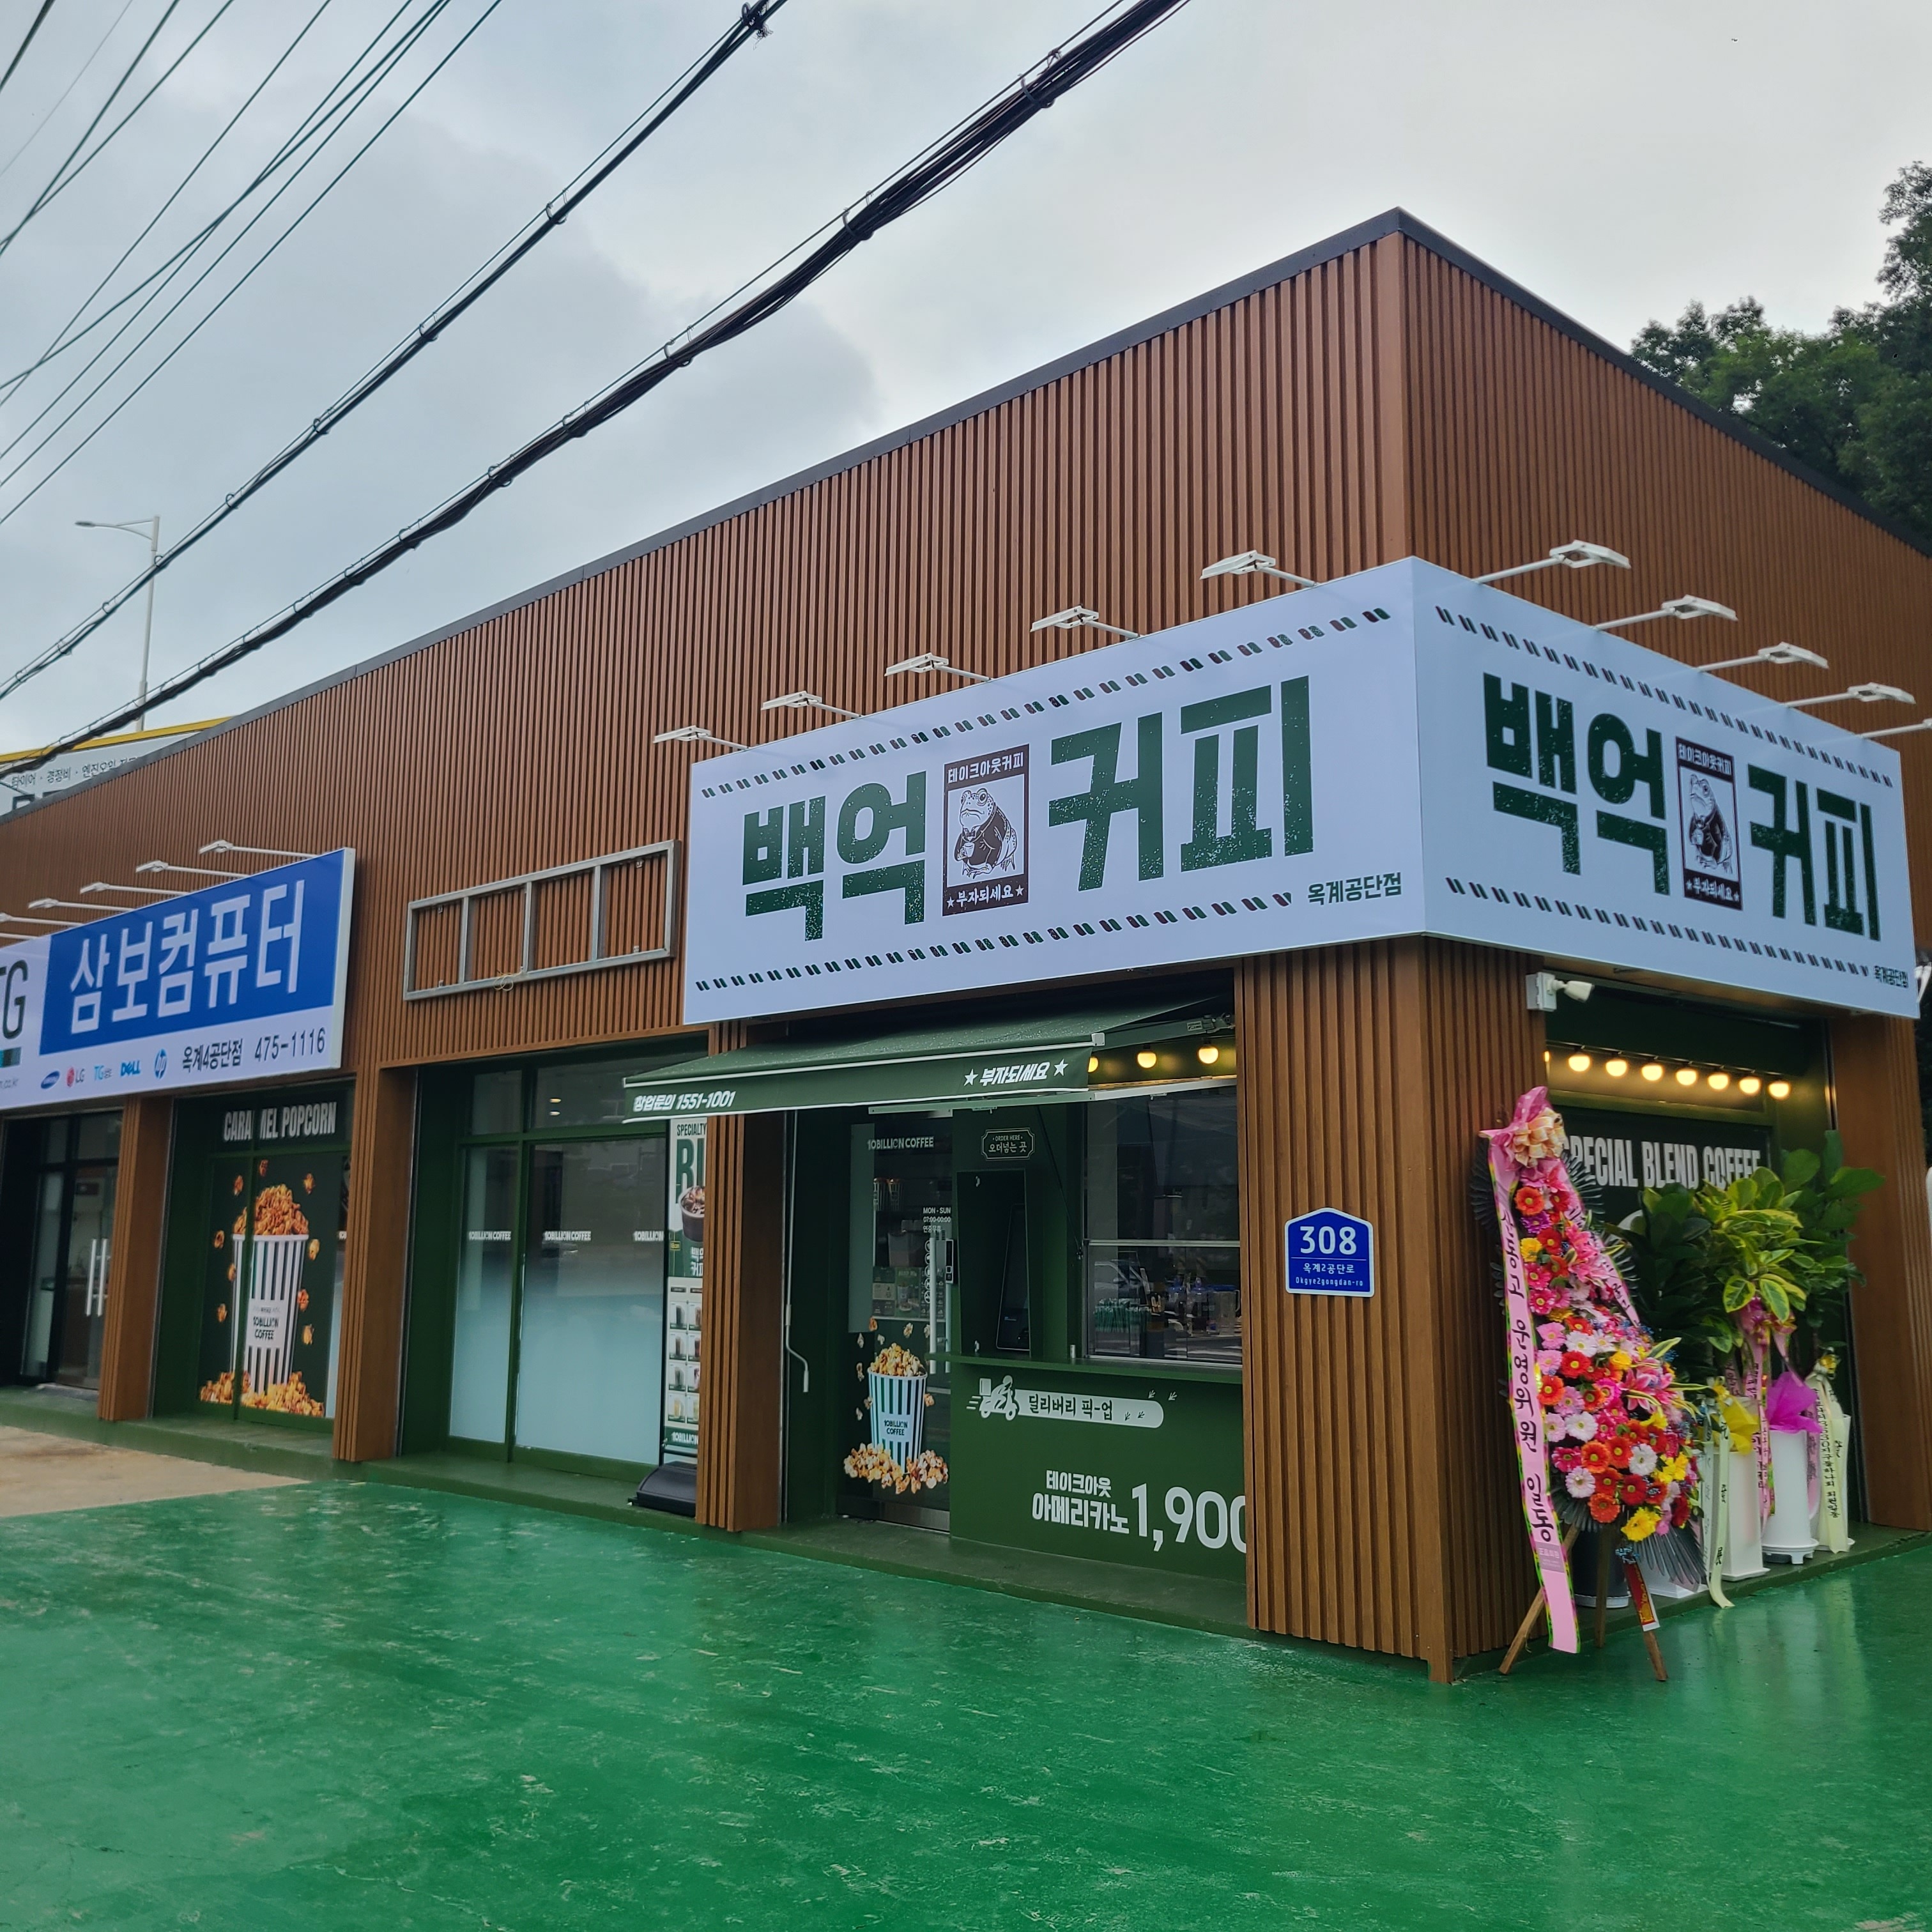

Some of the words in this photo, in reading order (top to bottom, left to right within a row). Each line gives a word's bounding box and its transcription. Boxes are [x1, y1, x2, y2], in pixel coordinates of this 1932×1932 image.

[947, 752, 1024, 784] 테이크아웃커피
[741, 770, 925, 942] 백억
[1047, 675, 1314, 892] 커피
[1483, 672, 1670, 896] 백억
[1747, 763, 1882, 942] 커피
[956, 884, 1014, 907] 부자되세요
[1307, 872, 1403, 906] 옥계공단점
[70, 879, 305, 1035] 삼보컴퓨터
[0, 960, 28, 1039] G
[182, 1038, 243, 1073] 옥계4공단점
[254, 1027, 326, 1062] 475-1116
[120, 1060, 141, 1077] DELL
[979, 1061, 1050, 1087] 부자되세요
[632, 1094, 677, 1112] 창업문의
[675, 1090, 736, 1110] 1551-1001
[281, 1101, 337, 1138] POPCORN
[677, 1123, 707, 1136] SPECIALTY
[905, 1136, 934, 1148] COFFEE
[988, 1141, 1017, 1153] 오더넣는
[1019, 1141, 1027, 1153] 곳
[1562, 1135, 1638, 1187] PECIAL
[1641, 1141, 1699, 1190] BLEND
[493, 1231, 512, 1241] COFFEE
[571, 1230, 591, 1241] COFFEE
[1300, 1226, 1357, 1255] 308
[1295, 1276, 1363, 1287] Okgye2gongdan-ro
[1303, 1262, 1355, 1275] 옥계2공단로
[1028, 1394, 1077, 1416] 딜리버리
[1081, 1399, 1114, 1422] 픽-업
[886, 1428, 905, 1436] COFFEE
[1046, 1469, 1112, 1498] 테이크아웃
[1031, 1492, 1130, 1535] 아메리카노
[1527, 1473, 1554, 1542] 일동
